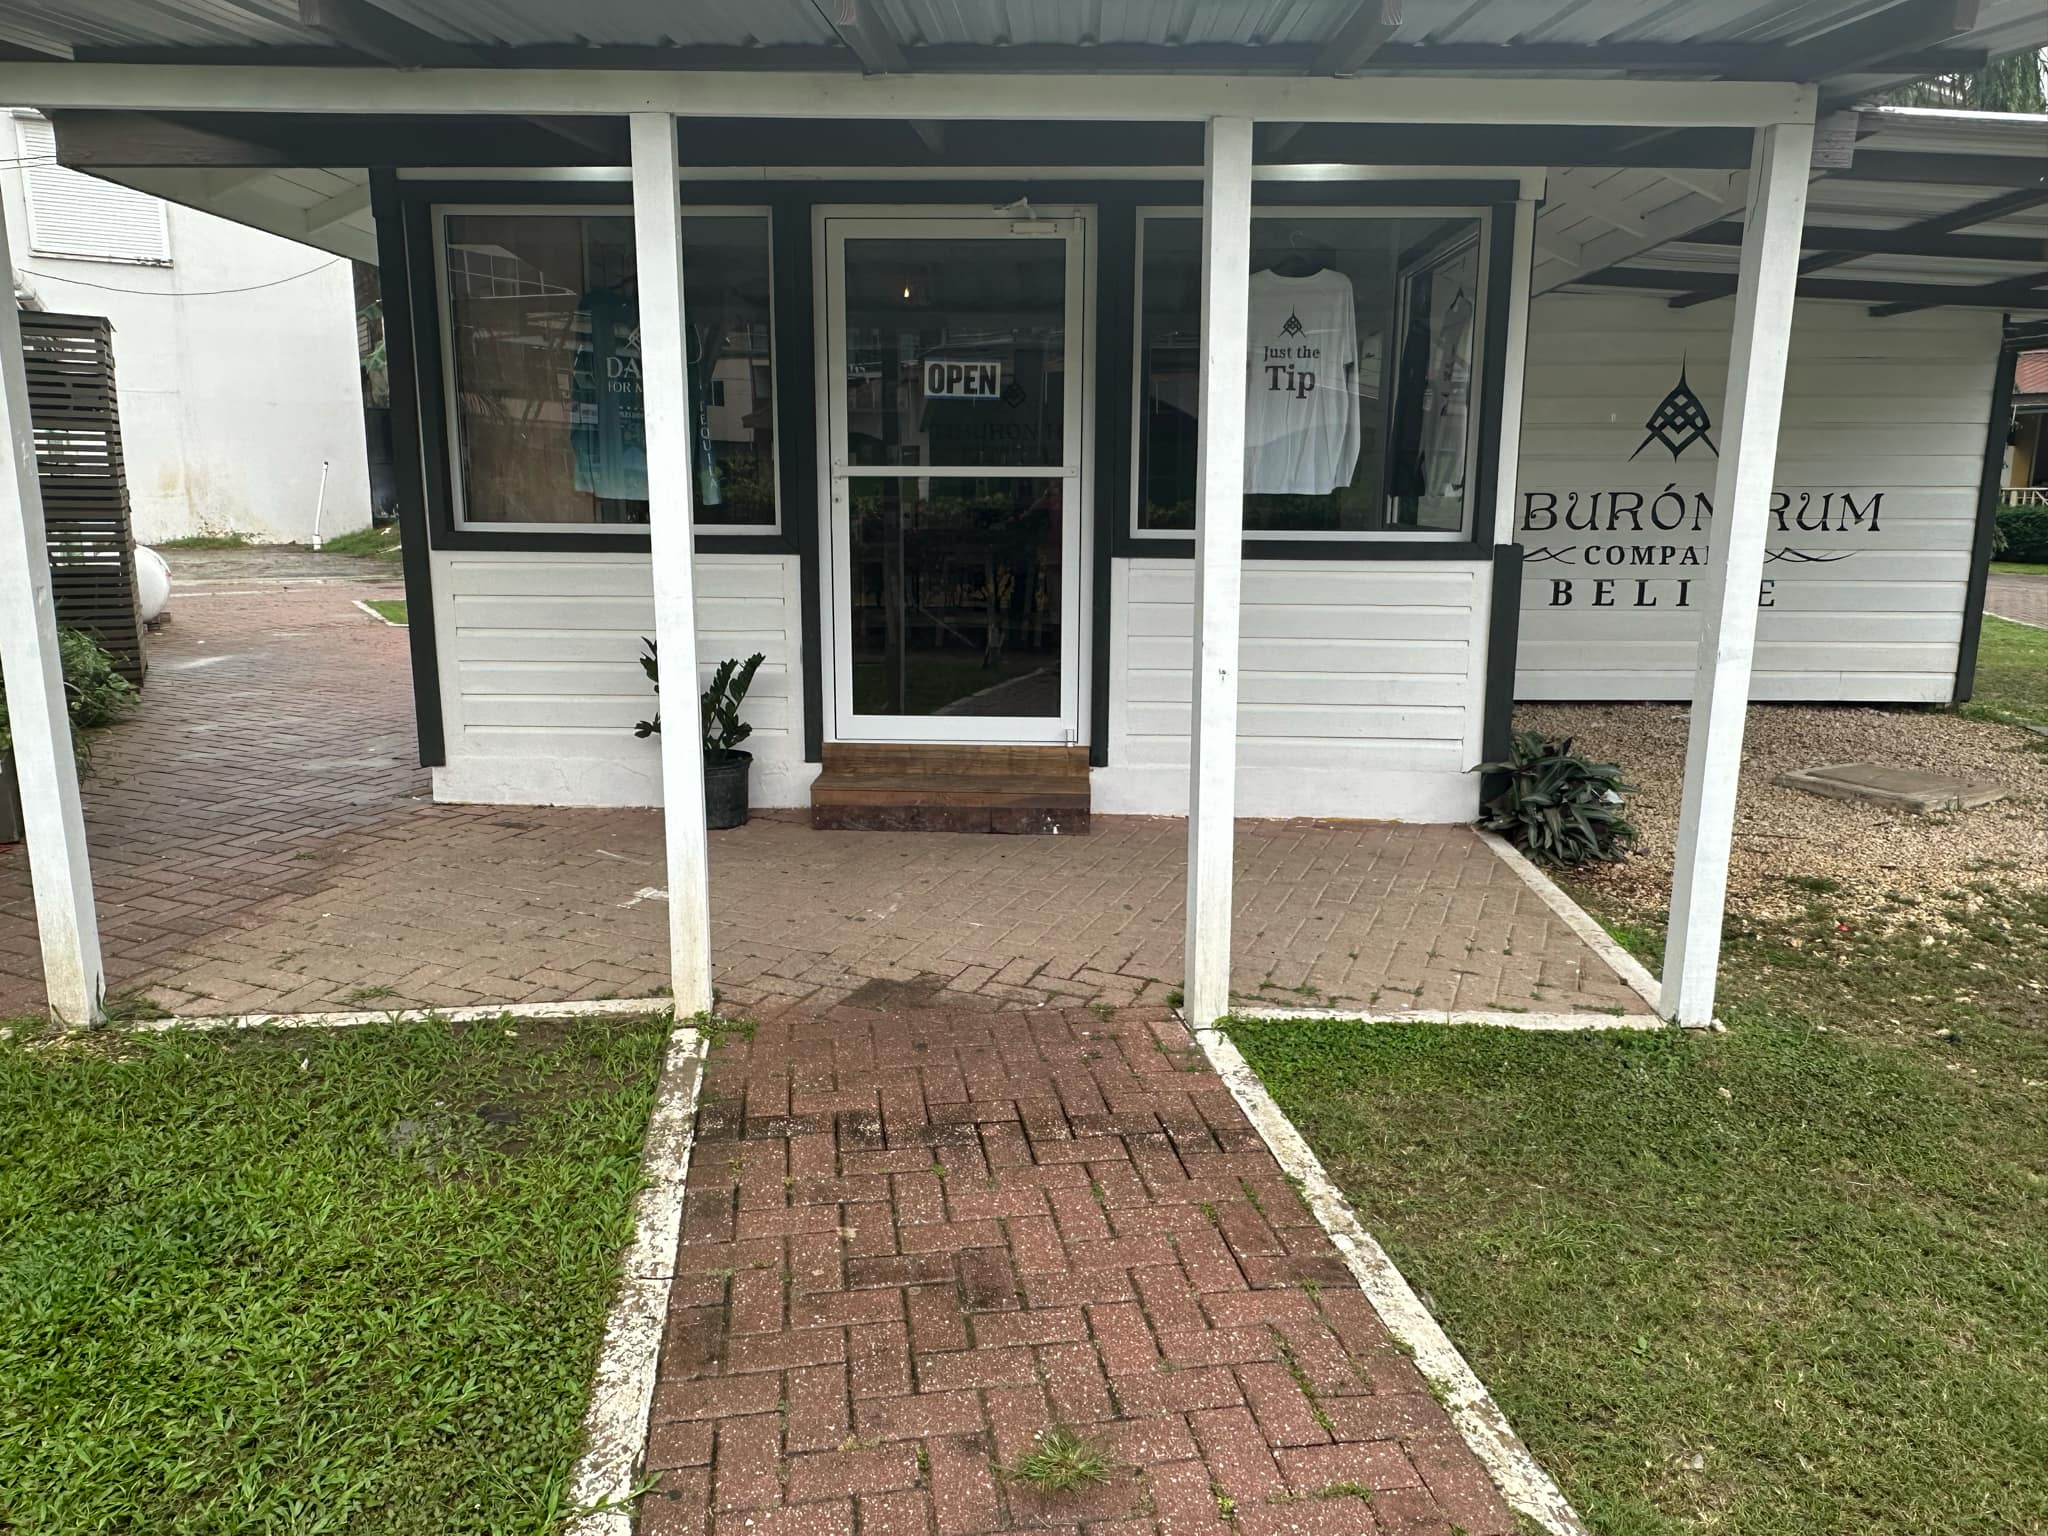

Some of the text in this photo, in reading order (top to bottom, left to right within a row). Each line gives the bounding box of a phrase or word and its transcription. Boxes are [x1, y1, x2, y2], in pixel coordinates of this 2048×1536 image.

[1264, 345, 1321, 361] Just the
[928, 363, 997, 395] OPEN
[1264, 364, 1316, 399] Tip
[1520, 483, 1885, 532] BURÓN RUM
[1584, 545, 1709, 566] COMPA
[1549, 578, 1776, 607] BELIE
